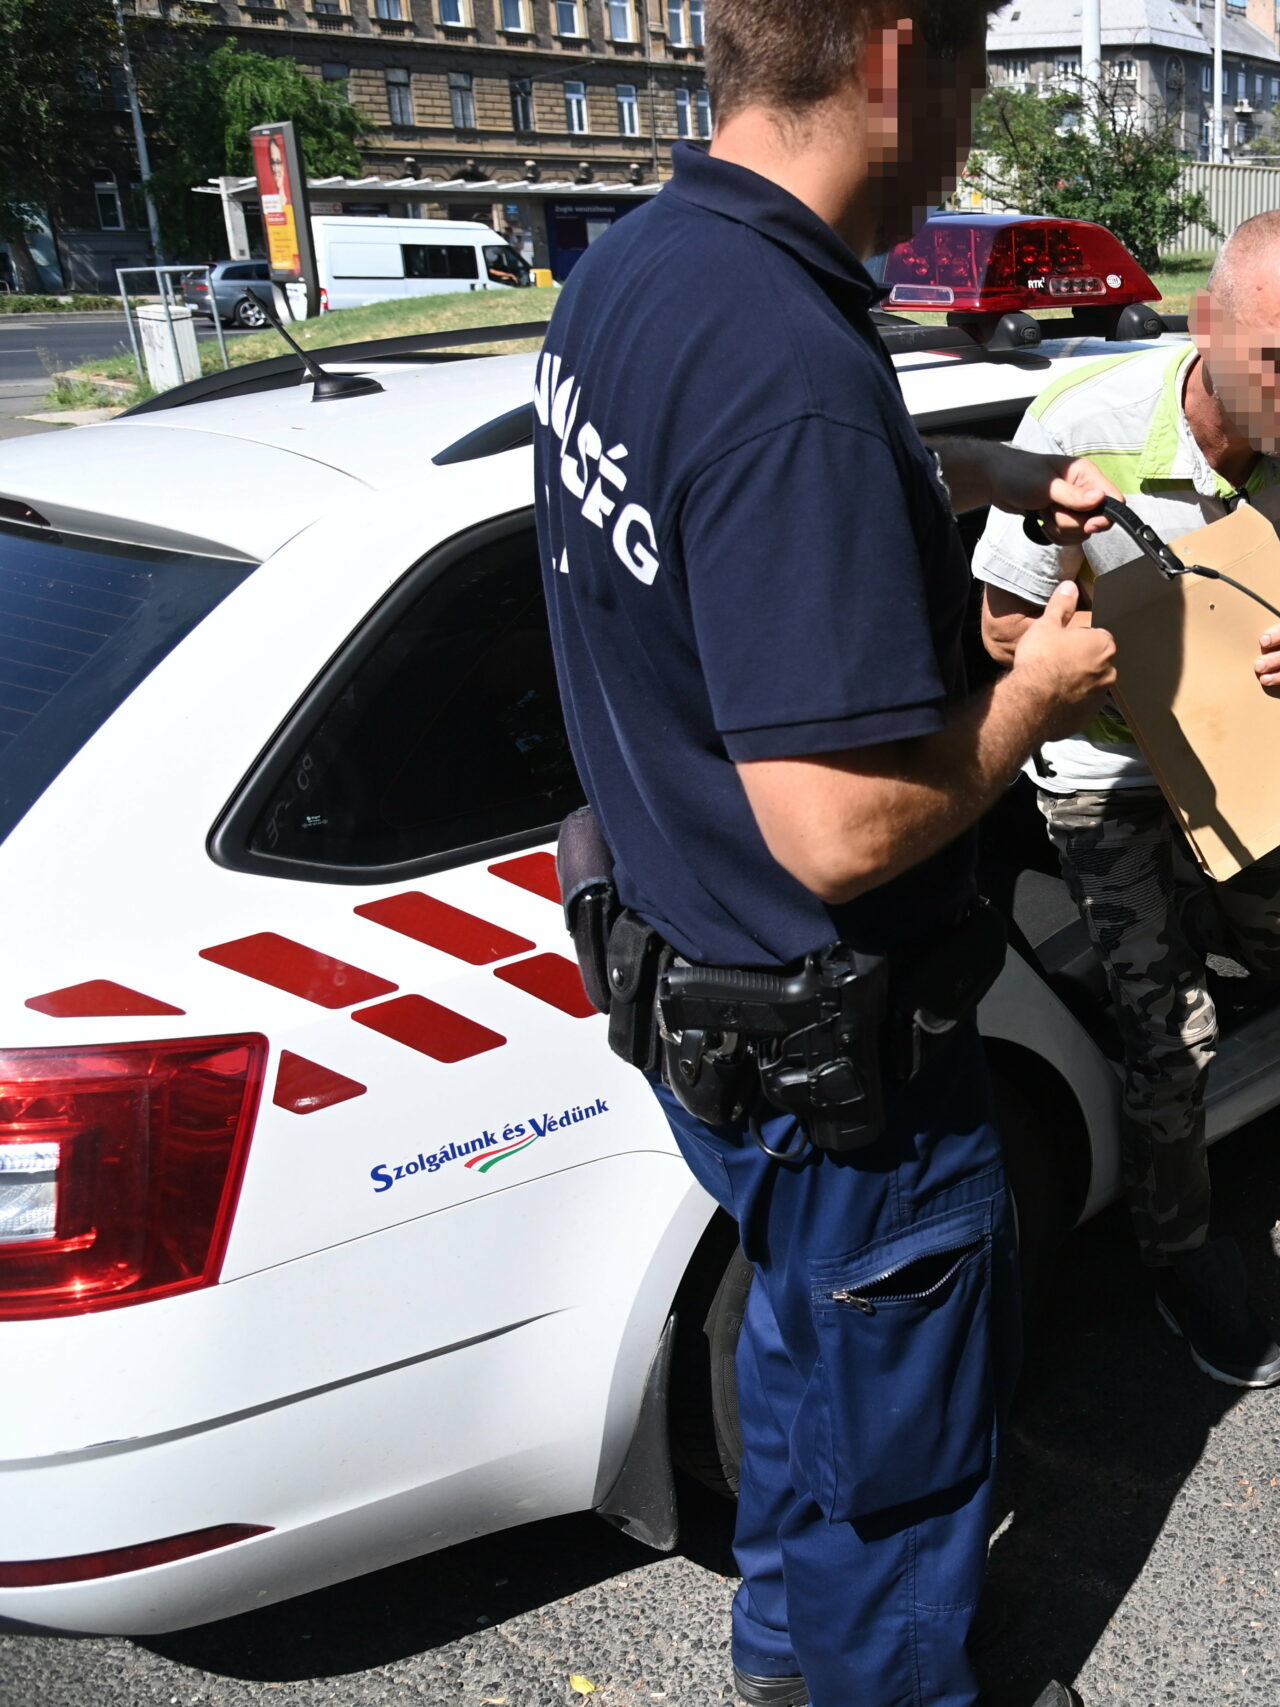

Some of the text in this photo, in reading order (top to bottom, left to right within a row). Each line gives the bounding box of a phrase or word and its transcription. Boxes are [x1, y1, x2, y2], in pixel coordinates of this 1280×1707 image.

[370, 1098, 609, 1193] Szolgálunk és Védünk
